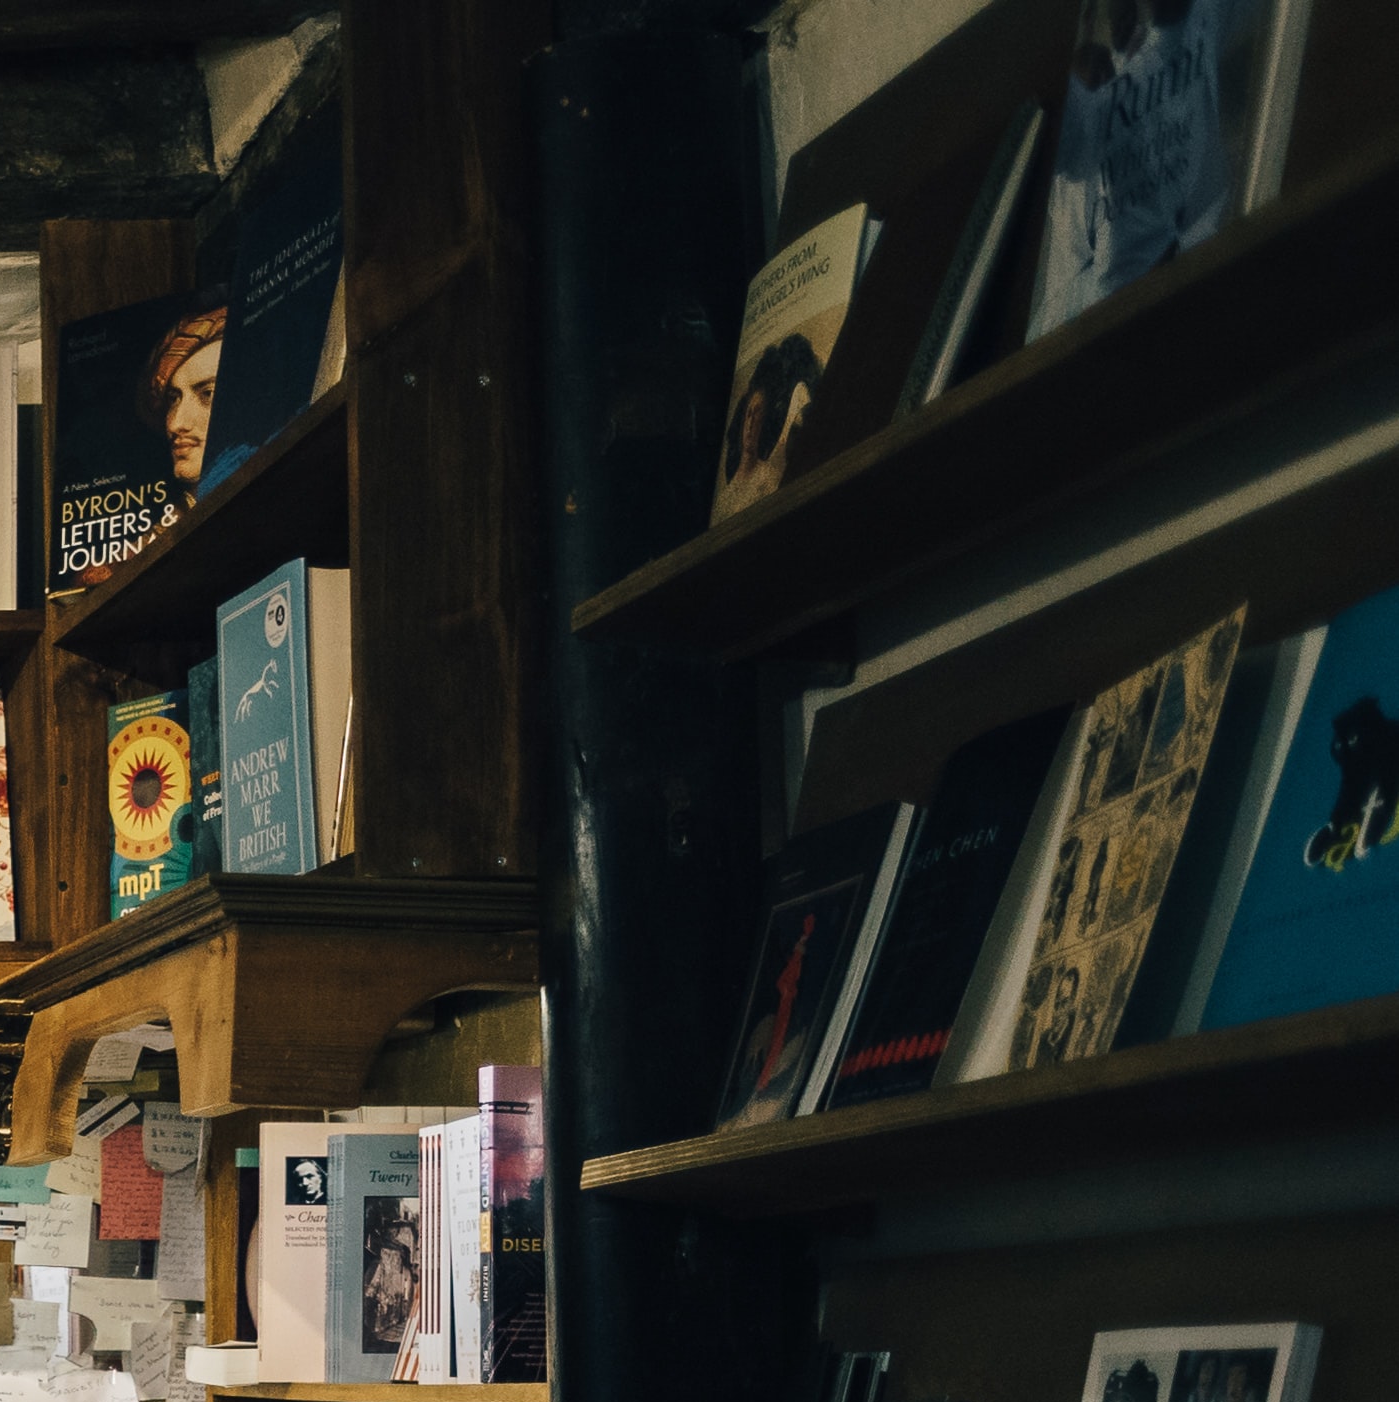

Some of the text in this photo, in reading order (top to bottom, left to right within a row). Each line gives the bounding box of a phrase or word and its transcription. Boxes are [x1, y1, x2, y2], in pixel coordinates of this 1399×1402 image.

[61, 480, 167, 524] BYRON'S
[71, 481, 91, 492] New
[61, 503, 179, 549] LETTERS &
[230, 735, 290, 786] ANDREW
[240, 771, 281, 805] MARR
[251, 802, 272, 826] WE
[239, 822, 287, 862] BRITISH
[369, 1170, 413, 1187] Twenty
[502, 1237, 544, 1252] DISE
